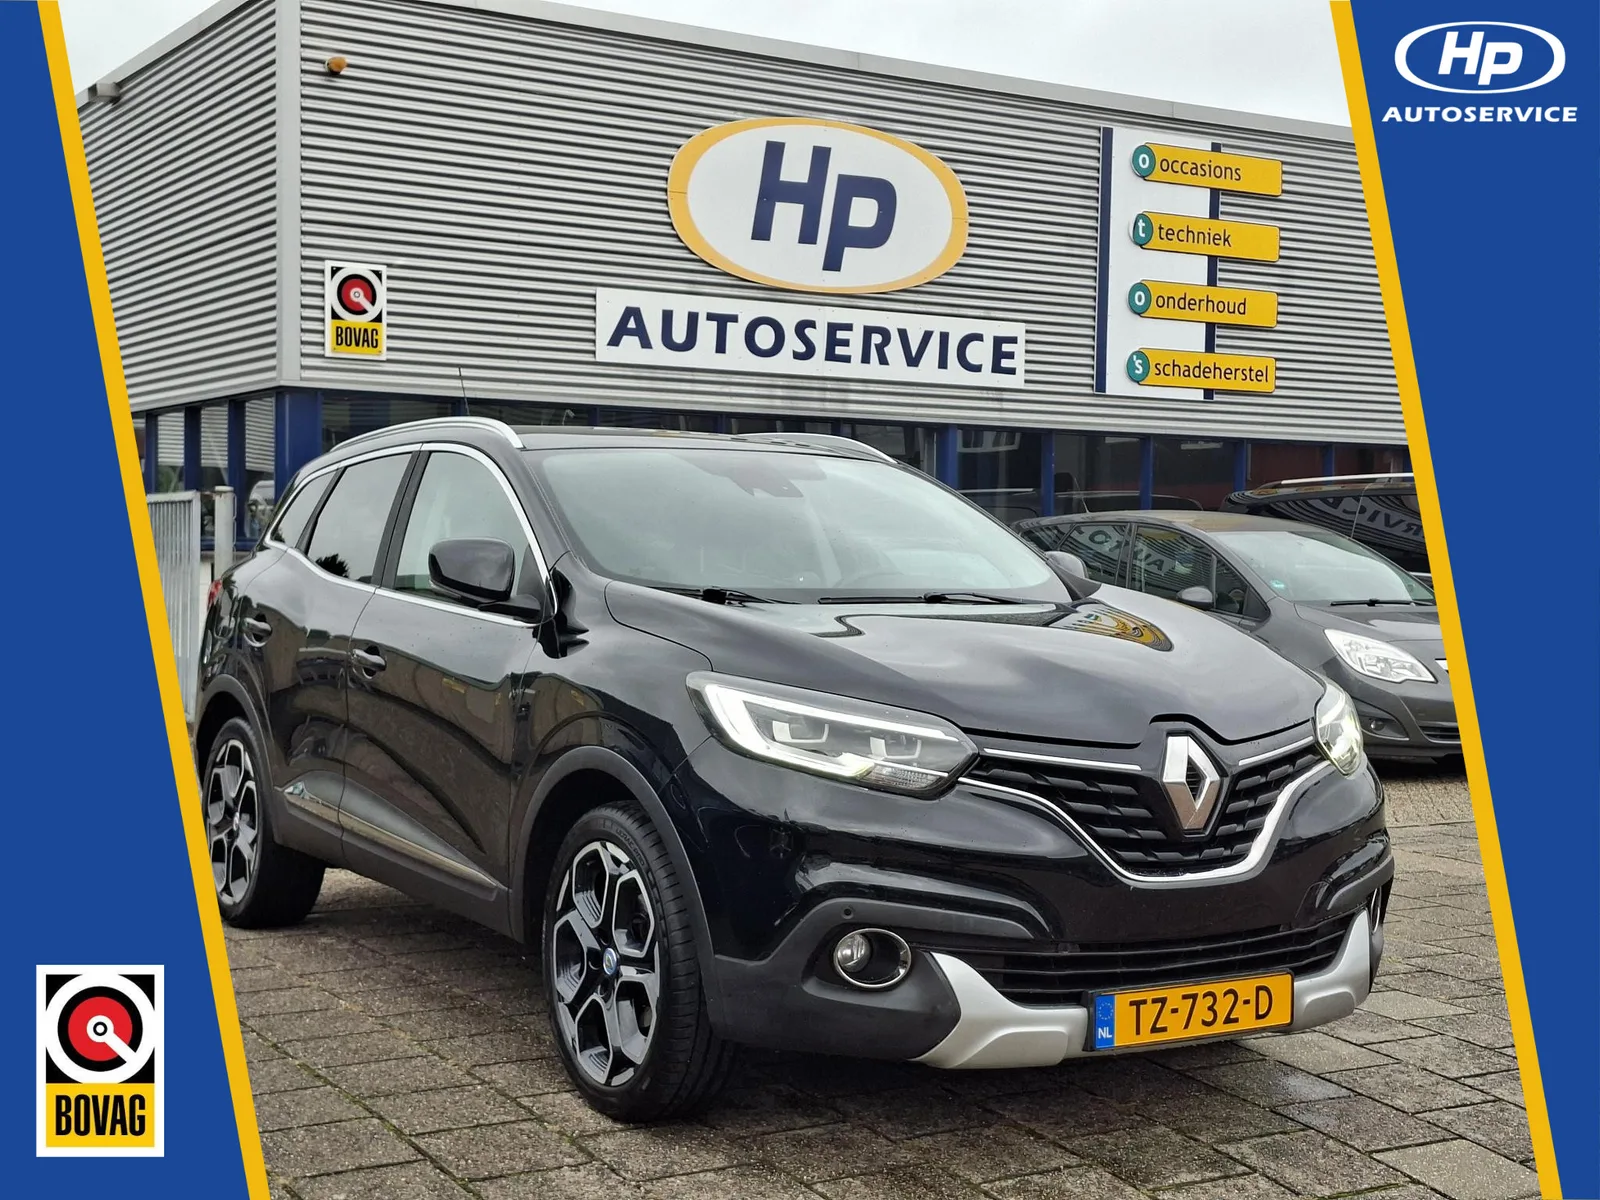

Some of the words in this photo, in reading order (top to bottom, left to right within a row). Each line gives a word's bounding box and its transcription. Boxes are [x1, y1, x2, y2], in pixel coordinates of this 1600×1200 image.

[1159, 157, 1242, 182] occasions
[751, 140, 897, 272] Hp
[1158, 223, 1232, 248] techniek
[1155, 292, 1247, 316] onderhoud
[335, 326, 379, 349] BOVAG
[606, 306, 1019, 375] AUTOSERVICE
[1154, 360, 1269, 383] schadeherstel
[1129, 985, 1273, 1036] TZ-732-D
[1098, 1027, 1112, 1039] NL
